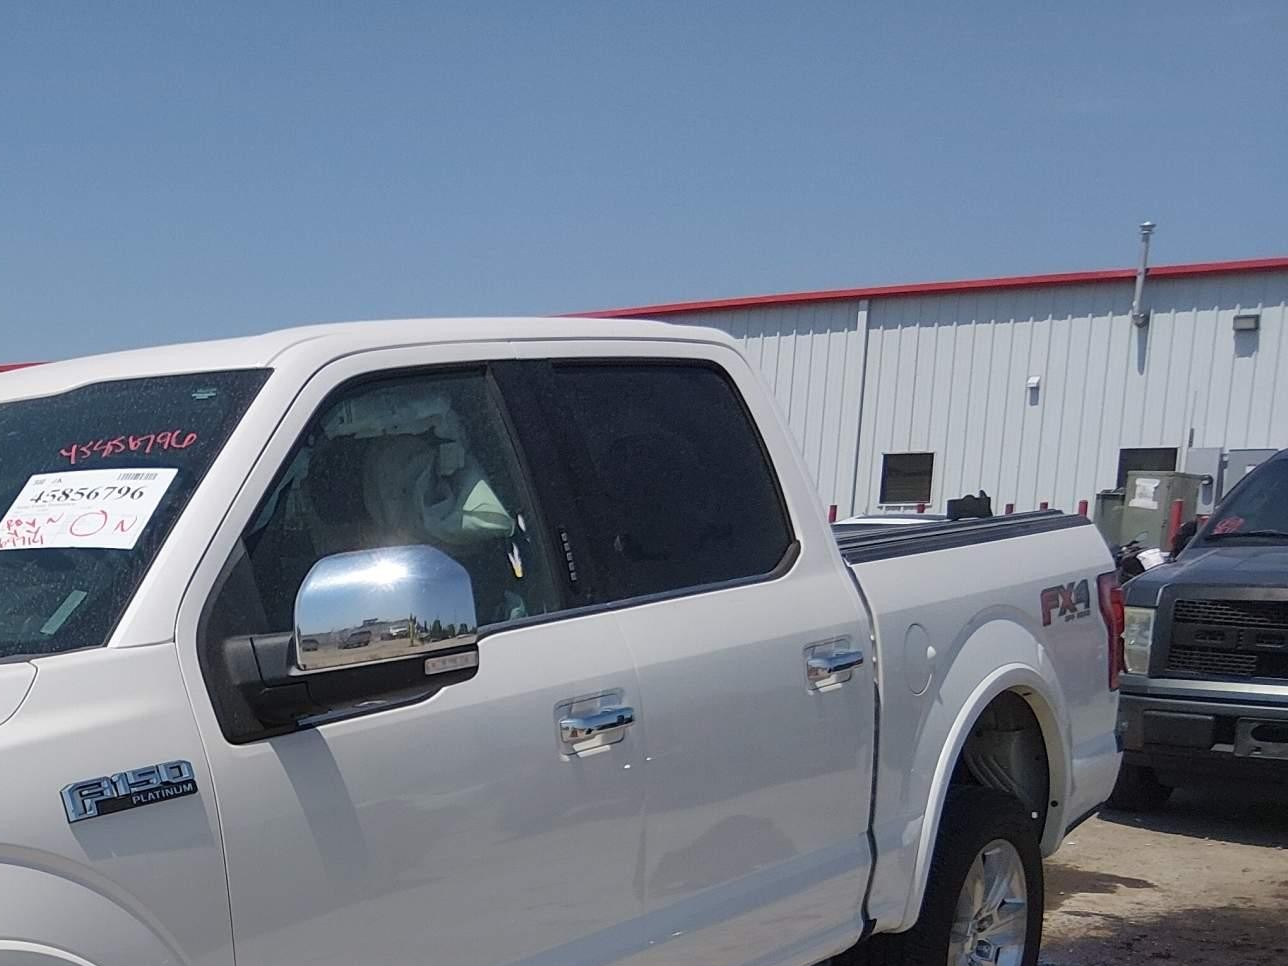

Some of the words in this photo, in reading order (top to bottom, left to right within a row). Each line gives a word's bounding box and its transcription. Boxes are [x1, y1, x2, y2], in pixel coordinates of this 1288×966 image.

[30, 485, 148, 504] 45856796
[1040, 579, 1091, 627] FX4
[132, 783, 194, 805] PLATINUM
